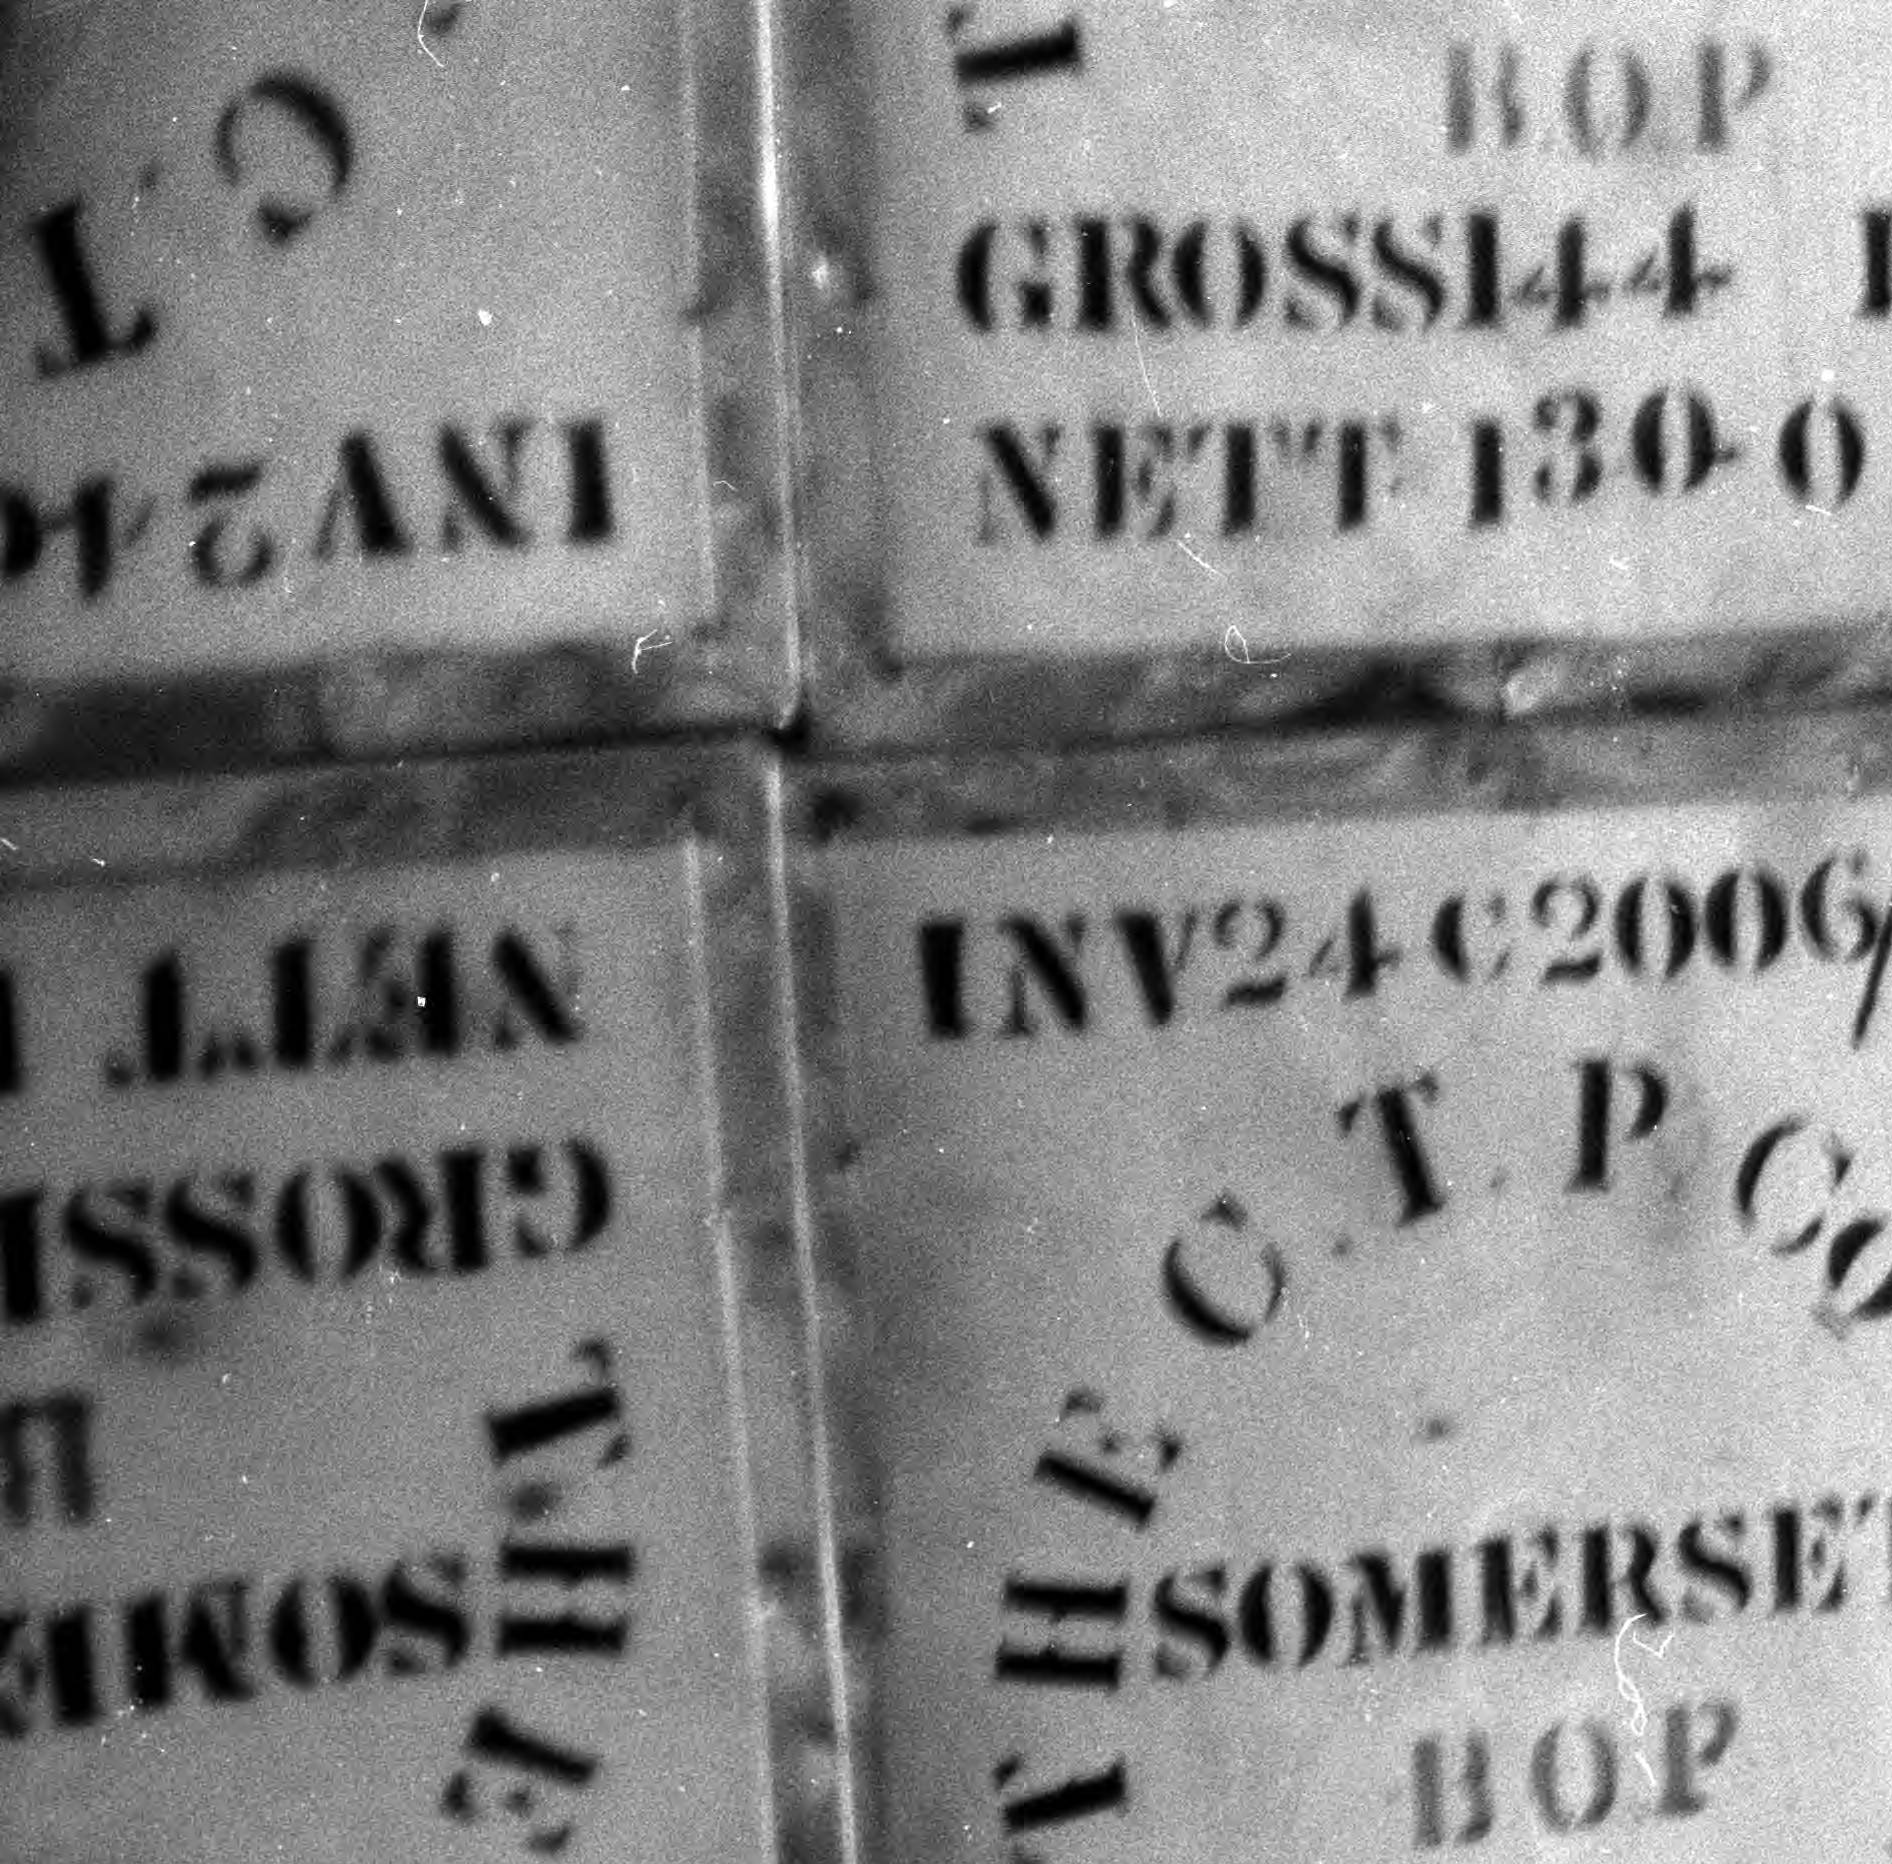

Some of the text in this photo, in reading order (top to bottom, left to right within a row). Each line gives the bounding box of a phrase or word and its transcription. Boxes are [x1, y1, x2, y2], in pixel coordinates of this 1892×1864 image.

[972, 421, 1398, 542] NETT
[104, 922, 583, 1091] NETT
[440, 1339, 635, 1853] THE
[1410, 1700, 1739, 1851] BOP
